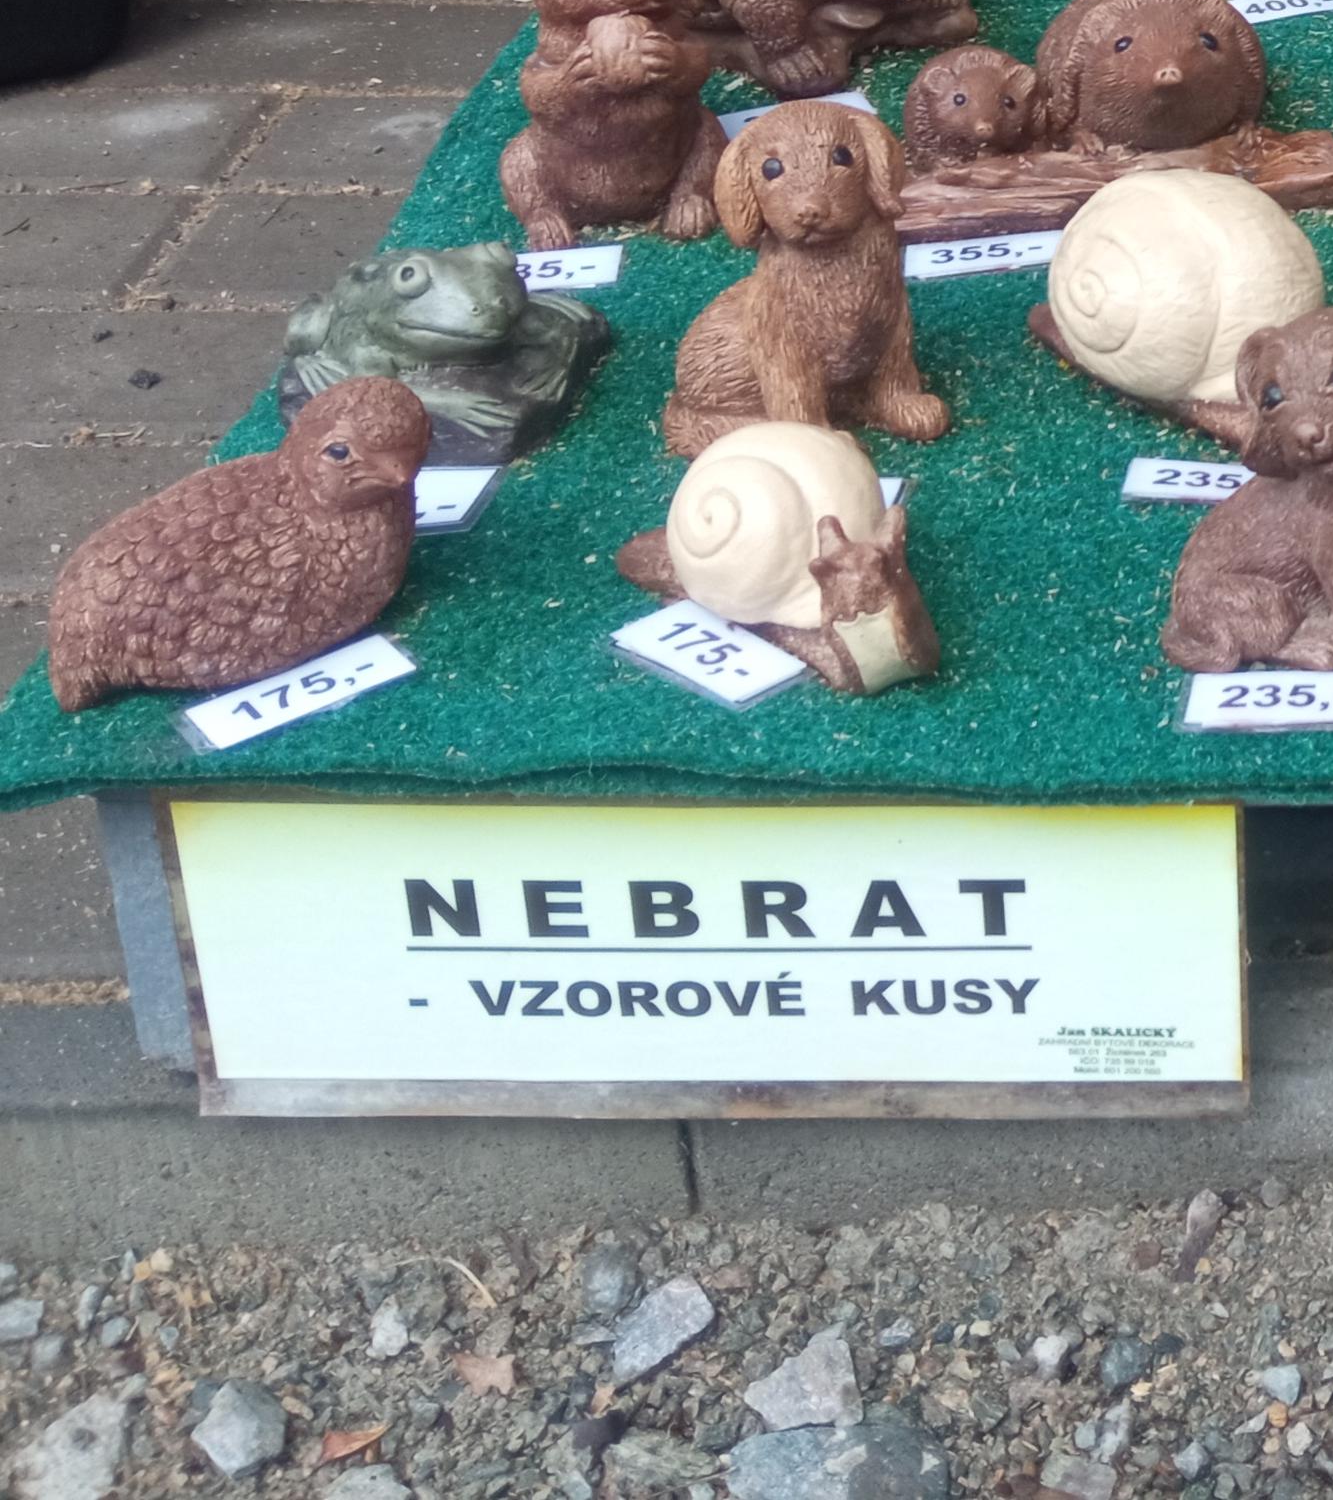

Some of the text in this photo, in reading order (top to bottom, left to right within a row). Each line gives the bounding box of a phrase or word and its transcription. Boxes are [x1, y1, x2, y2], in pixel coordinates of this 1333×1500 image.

[931, 242, 1043, 264] 355,-
[1152, 469, 1243, 489] 235
[658, 622, 750, 677] 175,-
[231, 663, 374, 720] 175,-
[403, 878, 1027, 939] NEBRAT
[468, 971, 807, 1017] VZOROVÉ
[850, 978, 1041, 1016] KUSY
[1057, 1026, 1086, 1037] Jan
